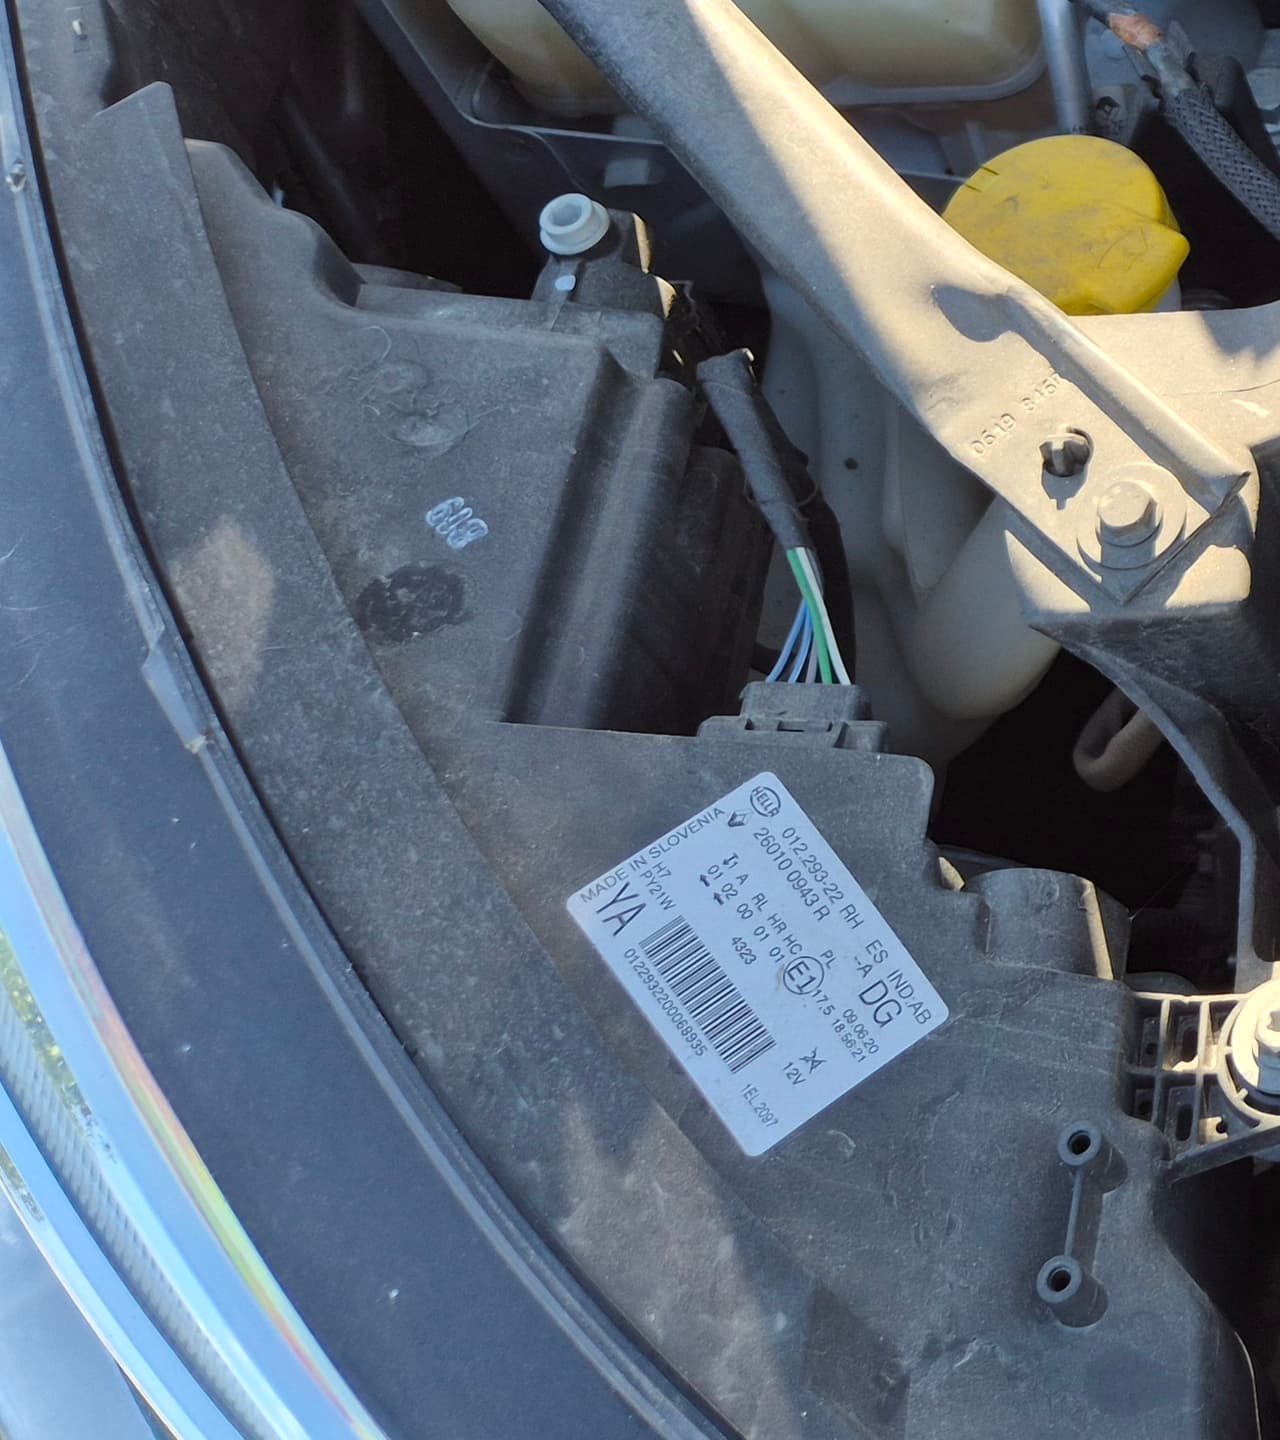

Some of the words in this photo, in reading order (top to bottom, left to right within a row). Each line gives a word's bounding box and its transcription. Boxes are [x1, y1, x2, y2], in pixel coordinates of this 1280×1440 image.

[579, 867, 630, 903] MADE
[628, 854, 649, 872] IN
[647, 807, 726, 860] SLOVENIA
[651, 860, 672, 879] H7
[752, 826, 793, 871] 26010
[786, 869, 820, 908] 0943
[812, 904, 831, 922] R
[595, 880, 647, 938] YA
[639, 869, 677, 911] PY21W
[781, 826, 845, 905] 012.293-22
[839, 903, 865, 930] RH
[864, 938, 889, 964] ES
[706, 864, 725, 881] 01
[720, 882, 739, 901] 02
[736, 902, 754, 920] 00
[752, 925, 771, 943] 01
[768, 946, 786, 964] 01
[751, 892, 769, 913] RL
[766, 912, 788, 936] HR
[781, 933, 803, 956] HC
[731, 936, 758, 966] 4323
[819, 949, 837, 970] PL
[785, 959, 817, 995] E1
[857, 978, 903, 1029] DG
[831, 1018, 870, 1063] 18:56:21
[841, 1008, 880, 1055] 09.06.20
[782, 1061, 807, 1086] 12V
